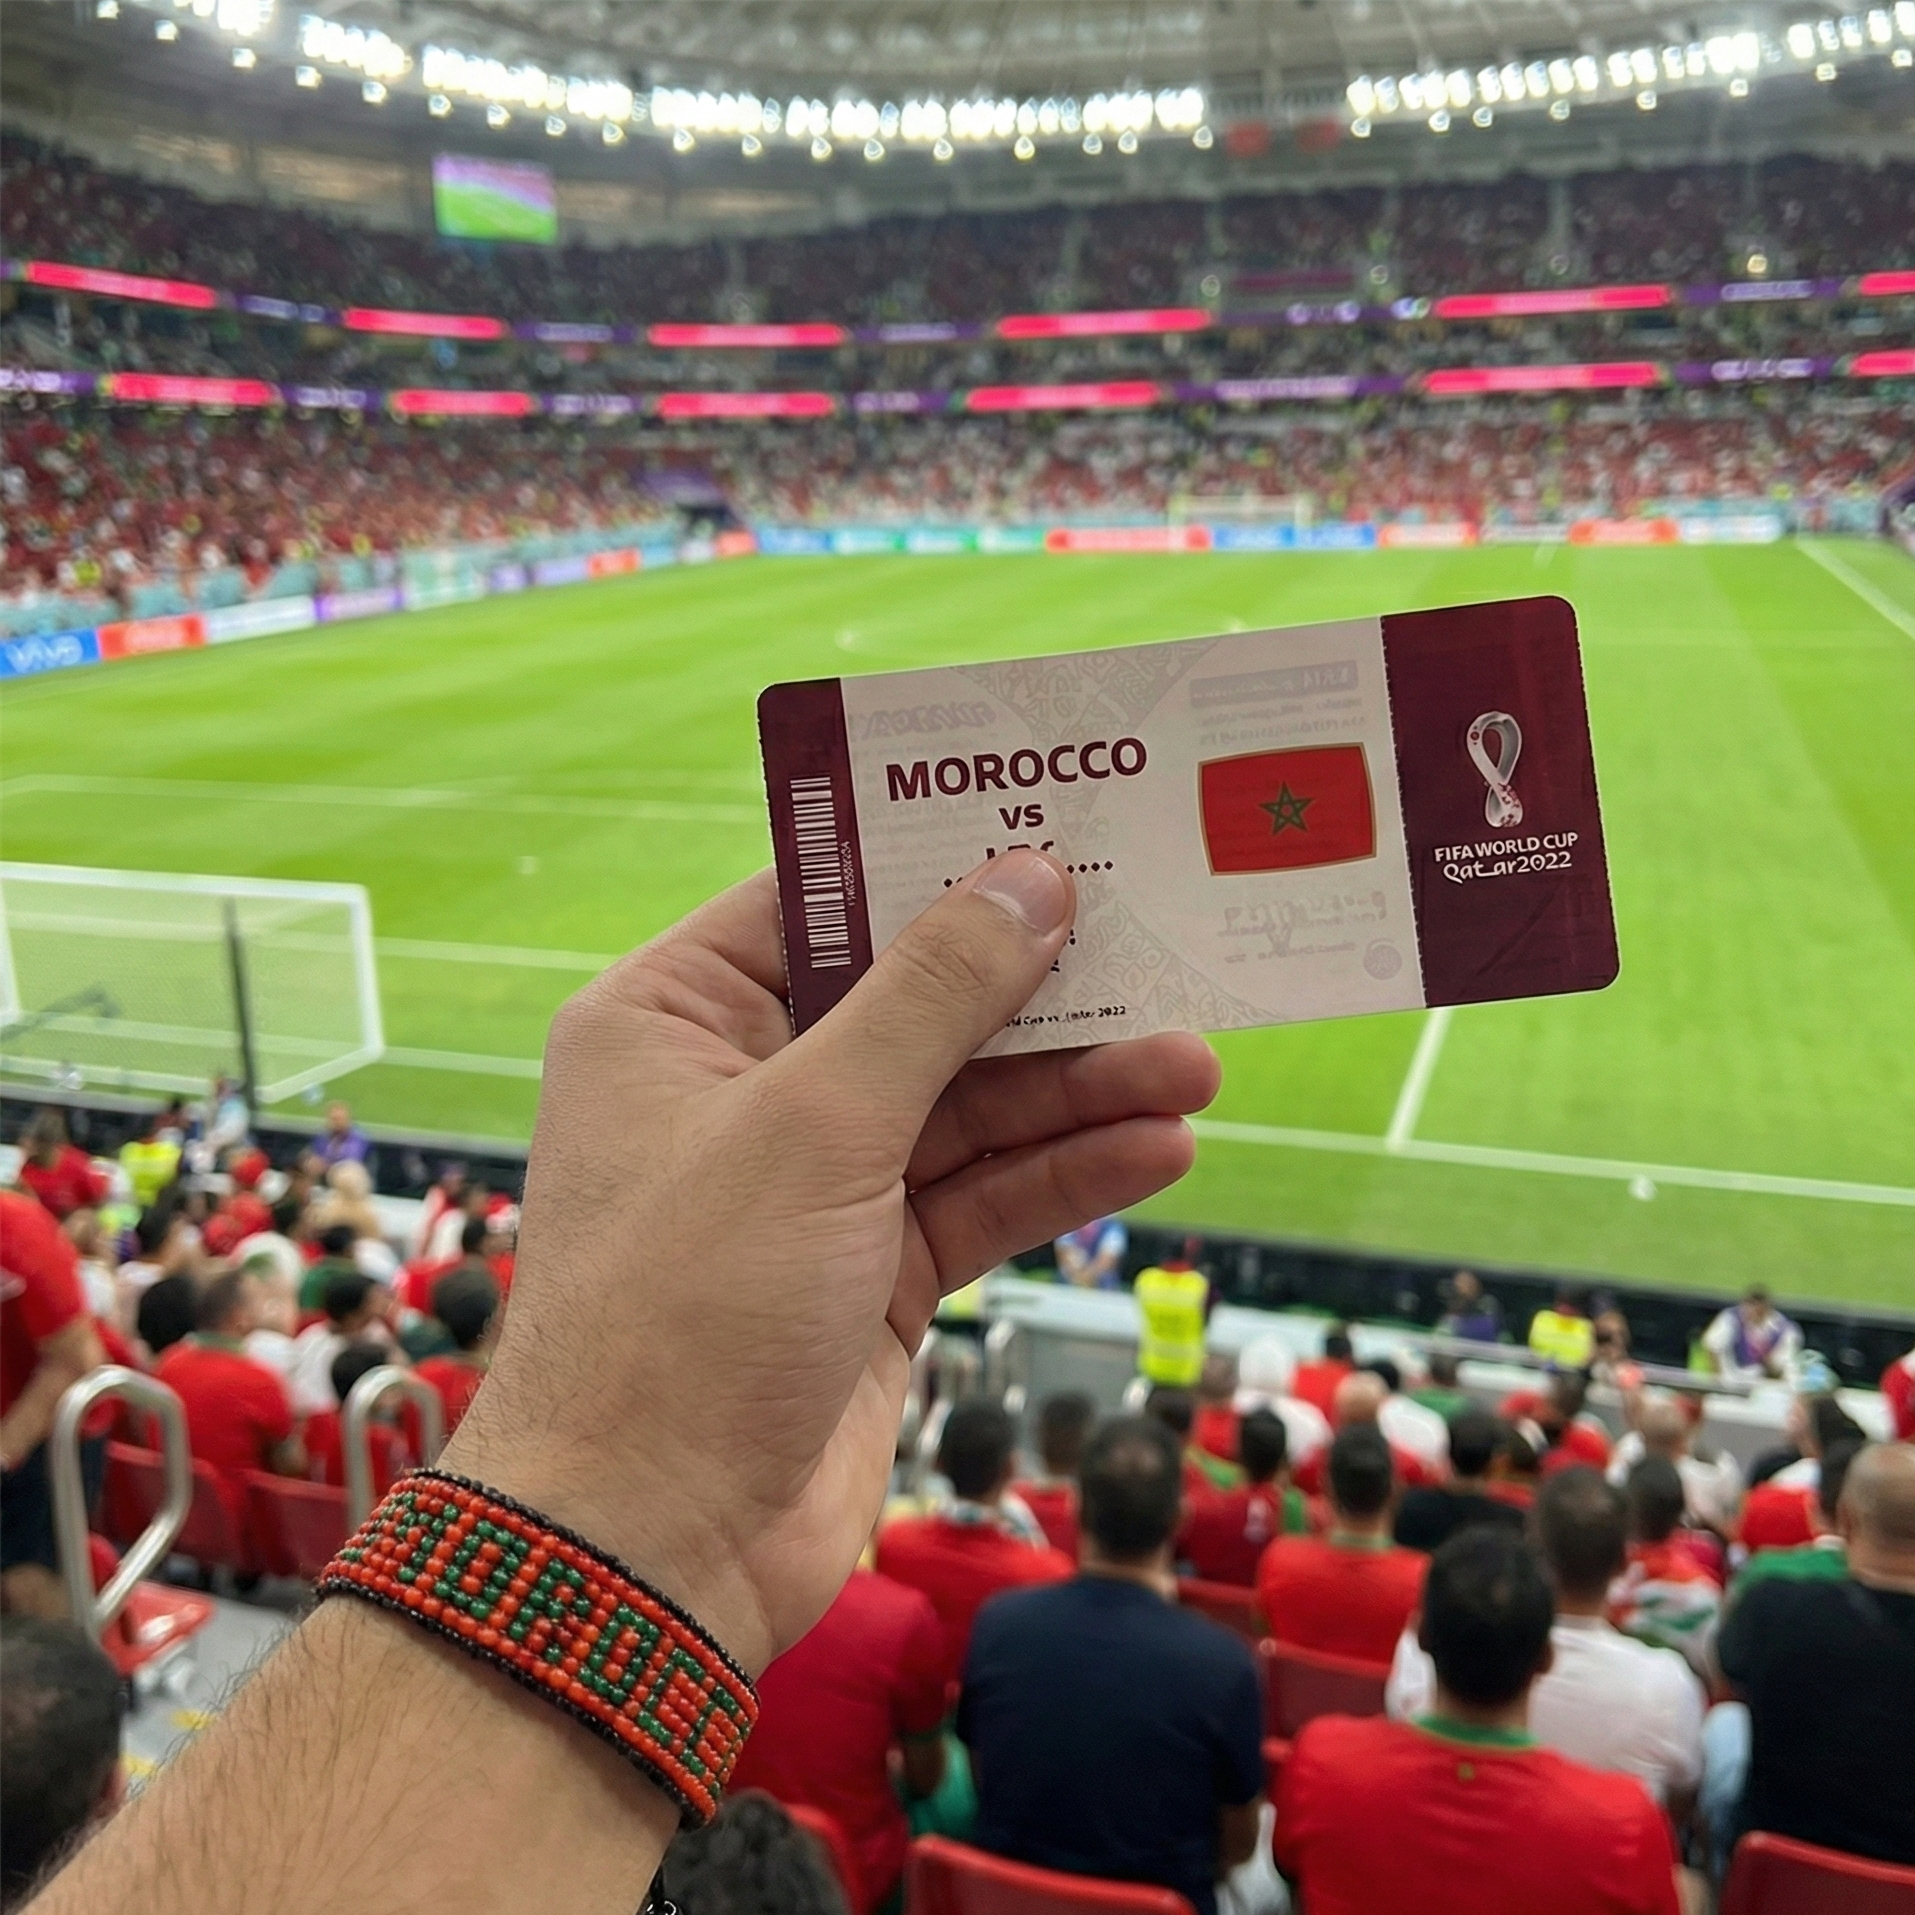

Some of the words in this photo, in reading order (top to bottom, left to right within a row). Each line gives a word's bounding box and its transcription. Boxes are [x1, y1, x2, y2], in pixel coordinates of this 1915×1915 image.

[885, 737, 1148, 802] MOROCCO
[1434, 844, 1475, 862] FIFA
[1475, 837, 1540, 857] WORLD
[1543, 831, 1579, 850] CUP
